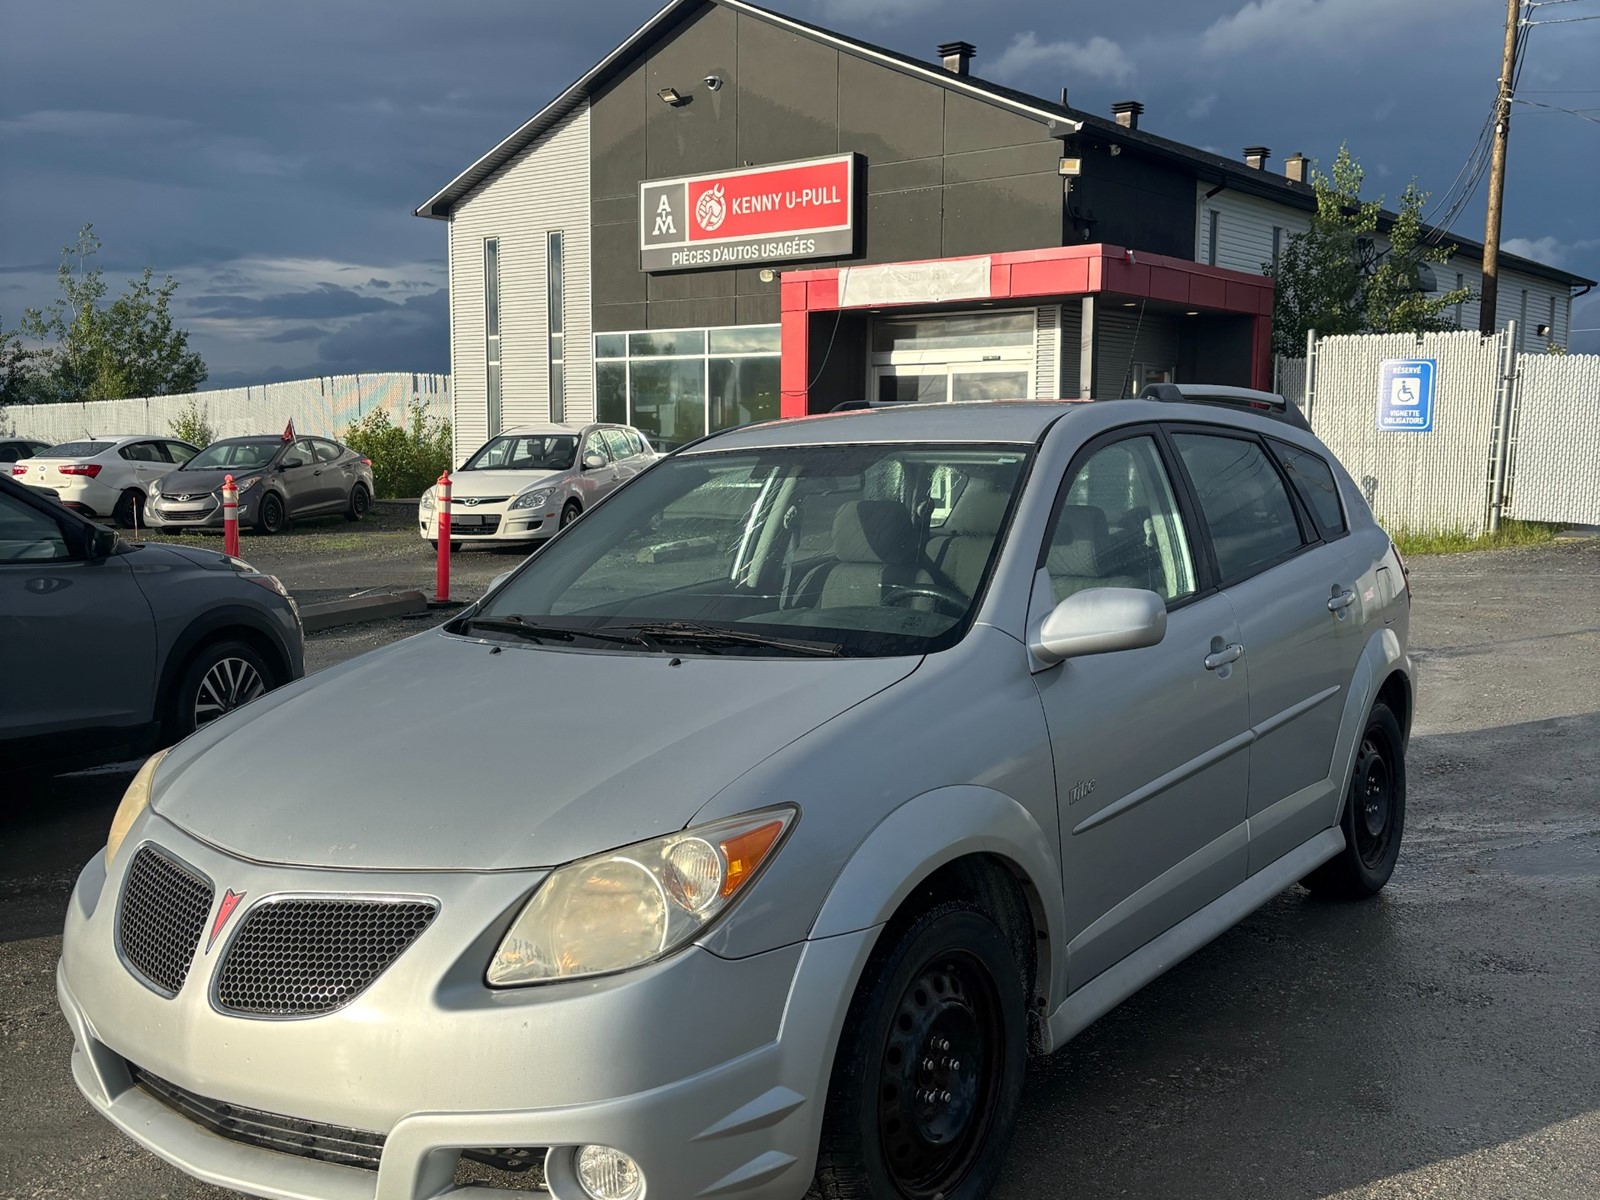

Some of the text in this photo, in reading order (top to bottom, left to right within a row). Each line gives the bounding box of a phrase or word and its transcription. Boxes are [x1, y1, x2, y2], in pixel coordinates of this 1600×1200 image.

[732, 185, 841, 215] KENNY U-PULL
[671, 237, 815, 266] PIÈCES D'AUTOS USAGÉES
[1383, 417, 1424, 425] OBLIGATOIRE
[1389, 409, 1420, 417] VIGNETTE
